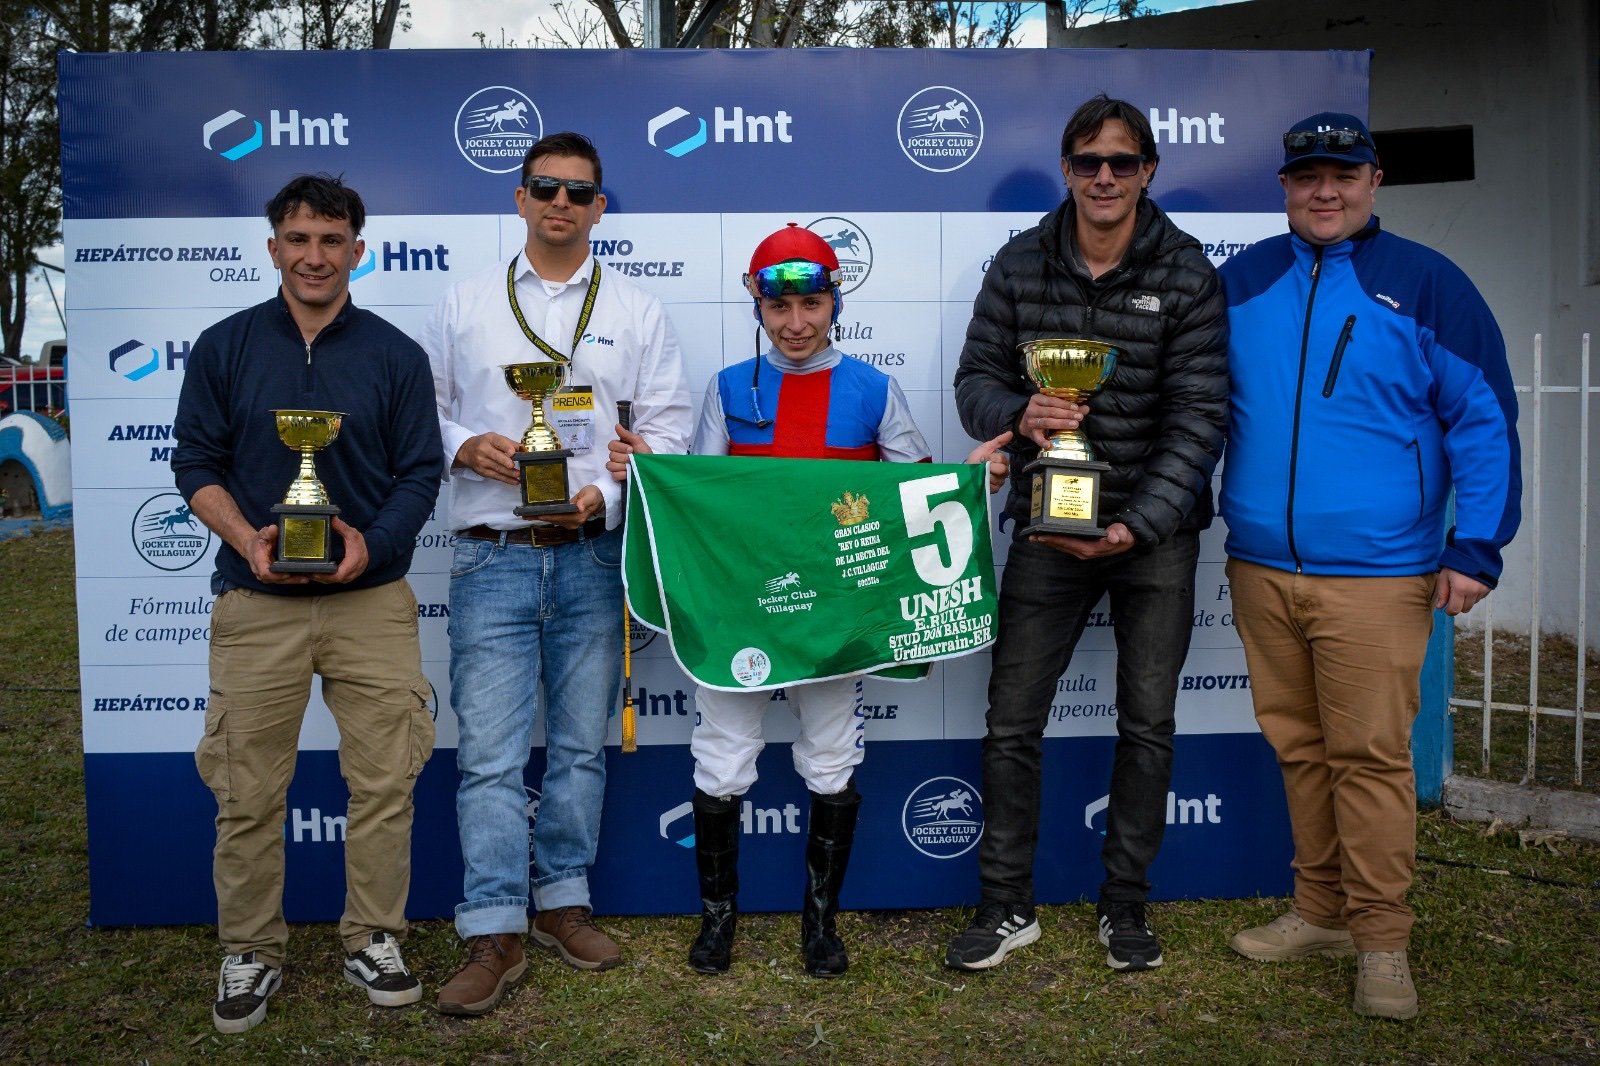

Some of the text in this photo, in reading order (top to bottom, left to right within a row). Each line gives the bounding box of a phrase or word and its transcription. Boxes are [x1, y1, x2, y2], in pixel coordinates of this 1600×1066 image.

[270, 109, 349, 146] Hnt
[714, 106, 793, 143] Hnt
[1149, 108, 1225, 145] Hnt
[465, 139, 533, 149] JOCKEY CLUB
[907, 138, 974, 148] JOCKEY CLUB
[470, 149, 527, 157] VILLAGUAY
[913, 148, 968, 157] VILLAGUAY
[75, 244, 242, 263] HEPÁTICO RENAL
[589, 239, 634, 256] INO
[383, 241, 450, 272] Hnt
[209, 267, 261, 283] ORAL
[597, 335, 615, 347] Hnt
[552, 396, 592, 407] PRENSA
[834, 520, 880, 538] GRAN CLASICO
[898, 472, 974, 587] 5
[141, 539, 203, 550] JOCKEY CLUB
[860, 534, 881, 546] REINA
[146, 549, 197, 558] VILLAGUAY
[835, 545, 891, 566] DE LA RECTA DEL
[757, 589, 817, 606] Jockey Club
[899, 575, 983, 621] UNESH
[765, 601, 813, 614] Villaguay
[913, 606, 967, 632] E.RUIZ
[1193, 609, 1215, 627] de
[105, 623, 129, 641] de
[889, 613, 993, 649] STUD DON BASILIO
[1181, 675, 1252, 690] BIOVIT
[93, 693, 190, 712] HEPÁTICO
[292, 807, 348, 842] Hn
[912, 825, 977, 836] JOCKEY CLUB
[917, 835, 971, 844] VILLAGUAY
